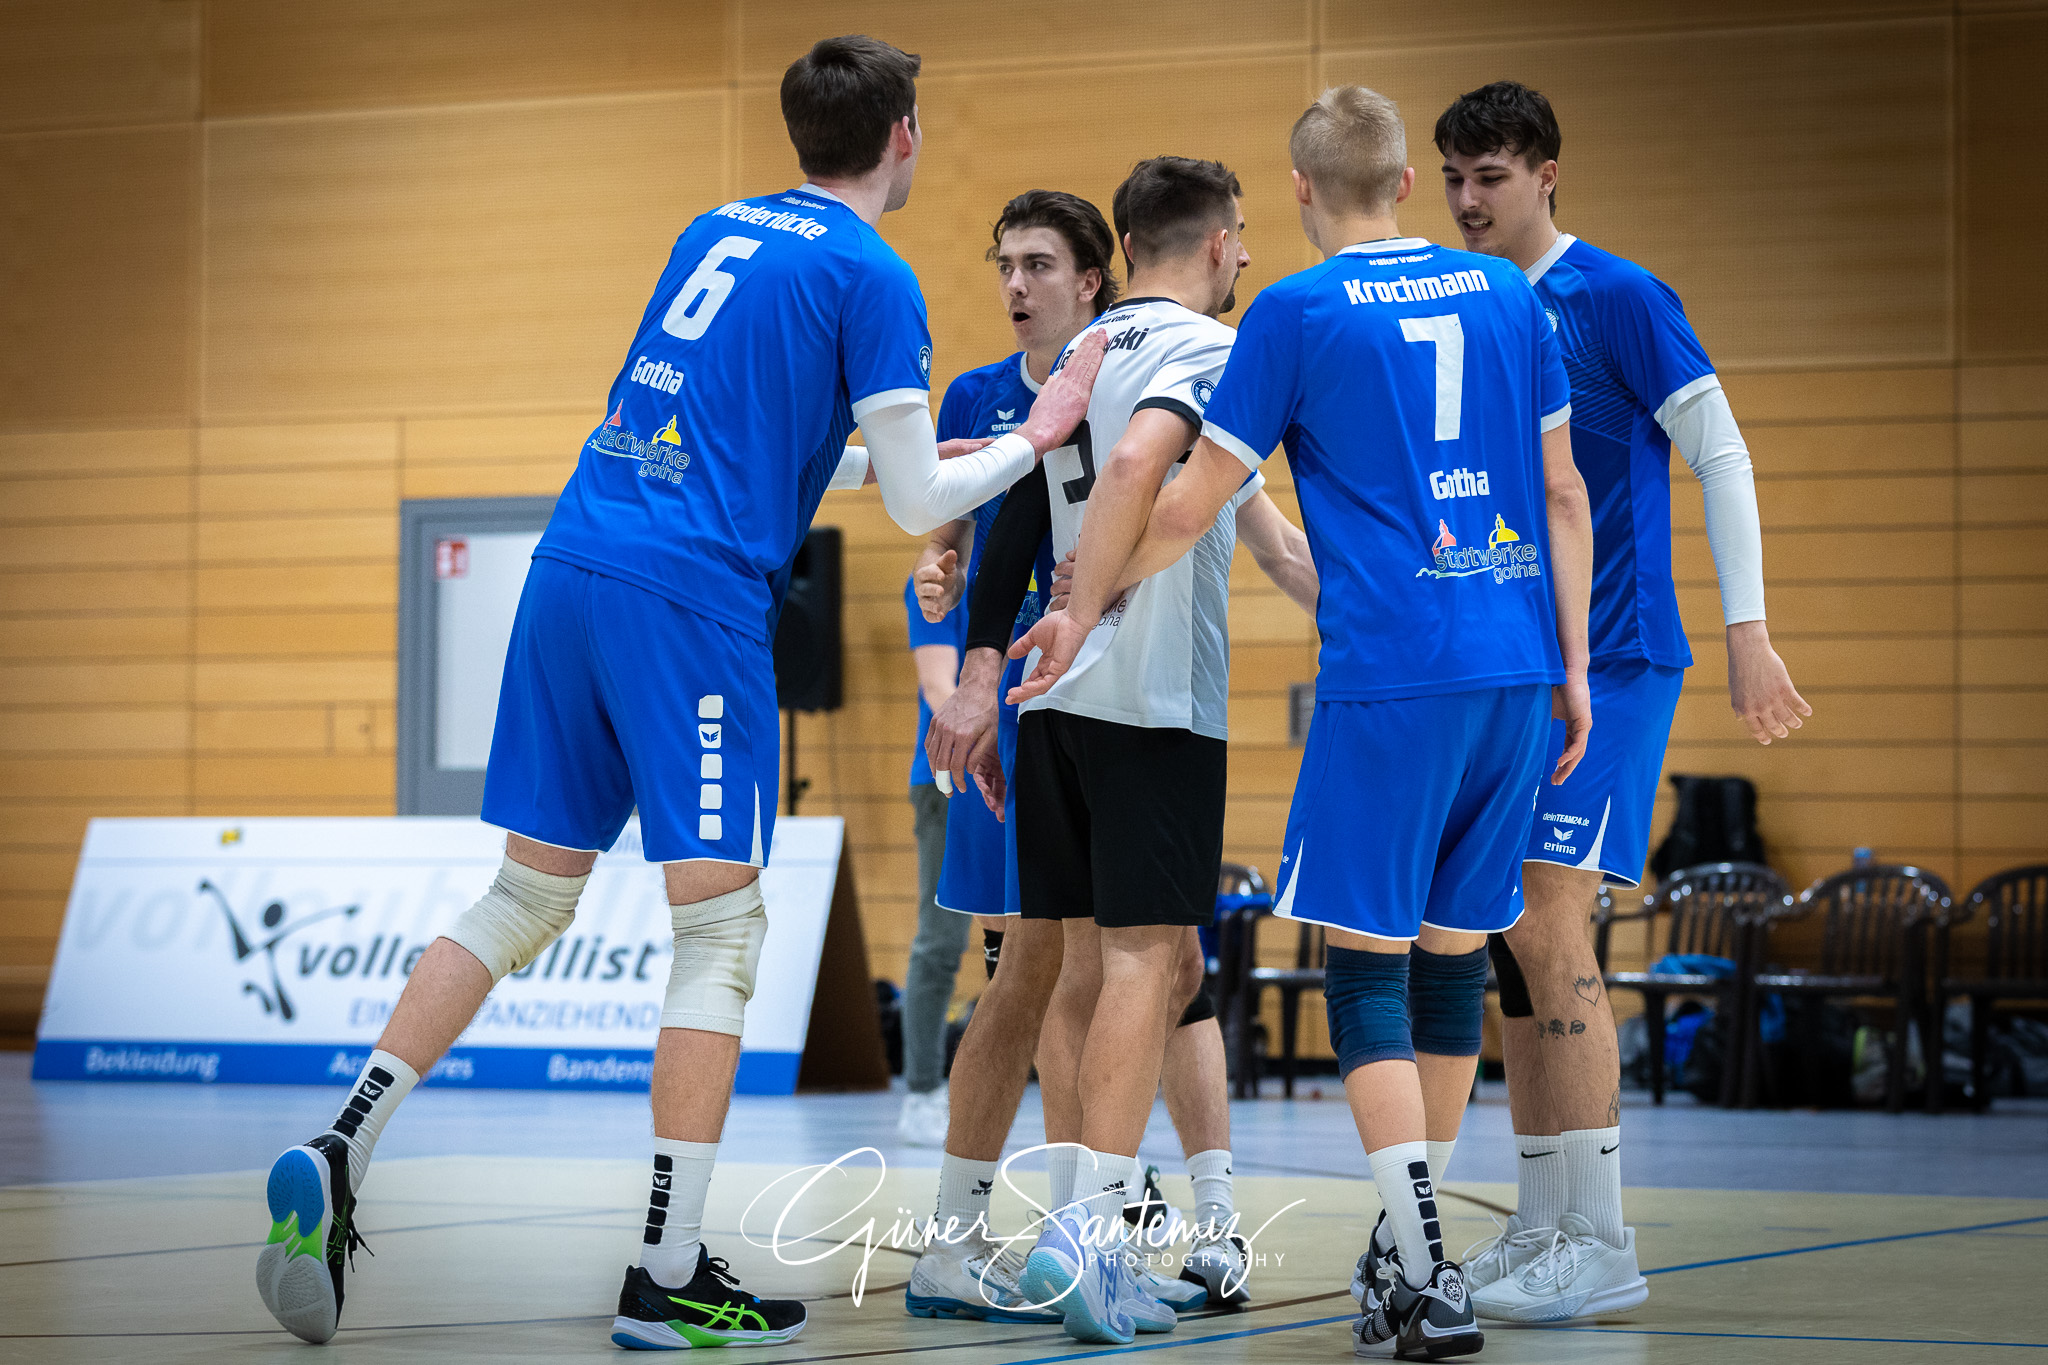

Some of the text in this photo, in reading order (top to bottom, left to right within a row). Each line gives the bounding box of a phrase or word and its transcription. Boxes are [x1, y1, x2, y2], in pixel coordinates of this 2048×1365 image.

[662, 235, 763, 341] 6
[1343, 269, 1490, 305] Krochmann
[630, 355, 685, 395] Gotha
[1398, 313, 1465, 442] 7
[597, 426, 691, 470] stadtwerke
[638, 461, 684, 484] gotha
[1429, 468, 1490, 500] Gotha
[1543, 841, 1577, 855] erima
[85, 1046, 220, 1081] Bekleidung
